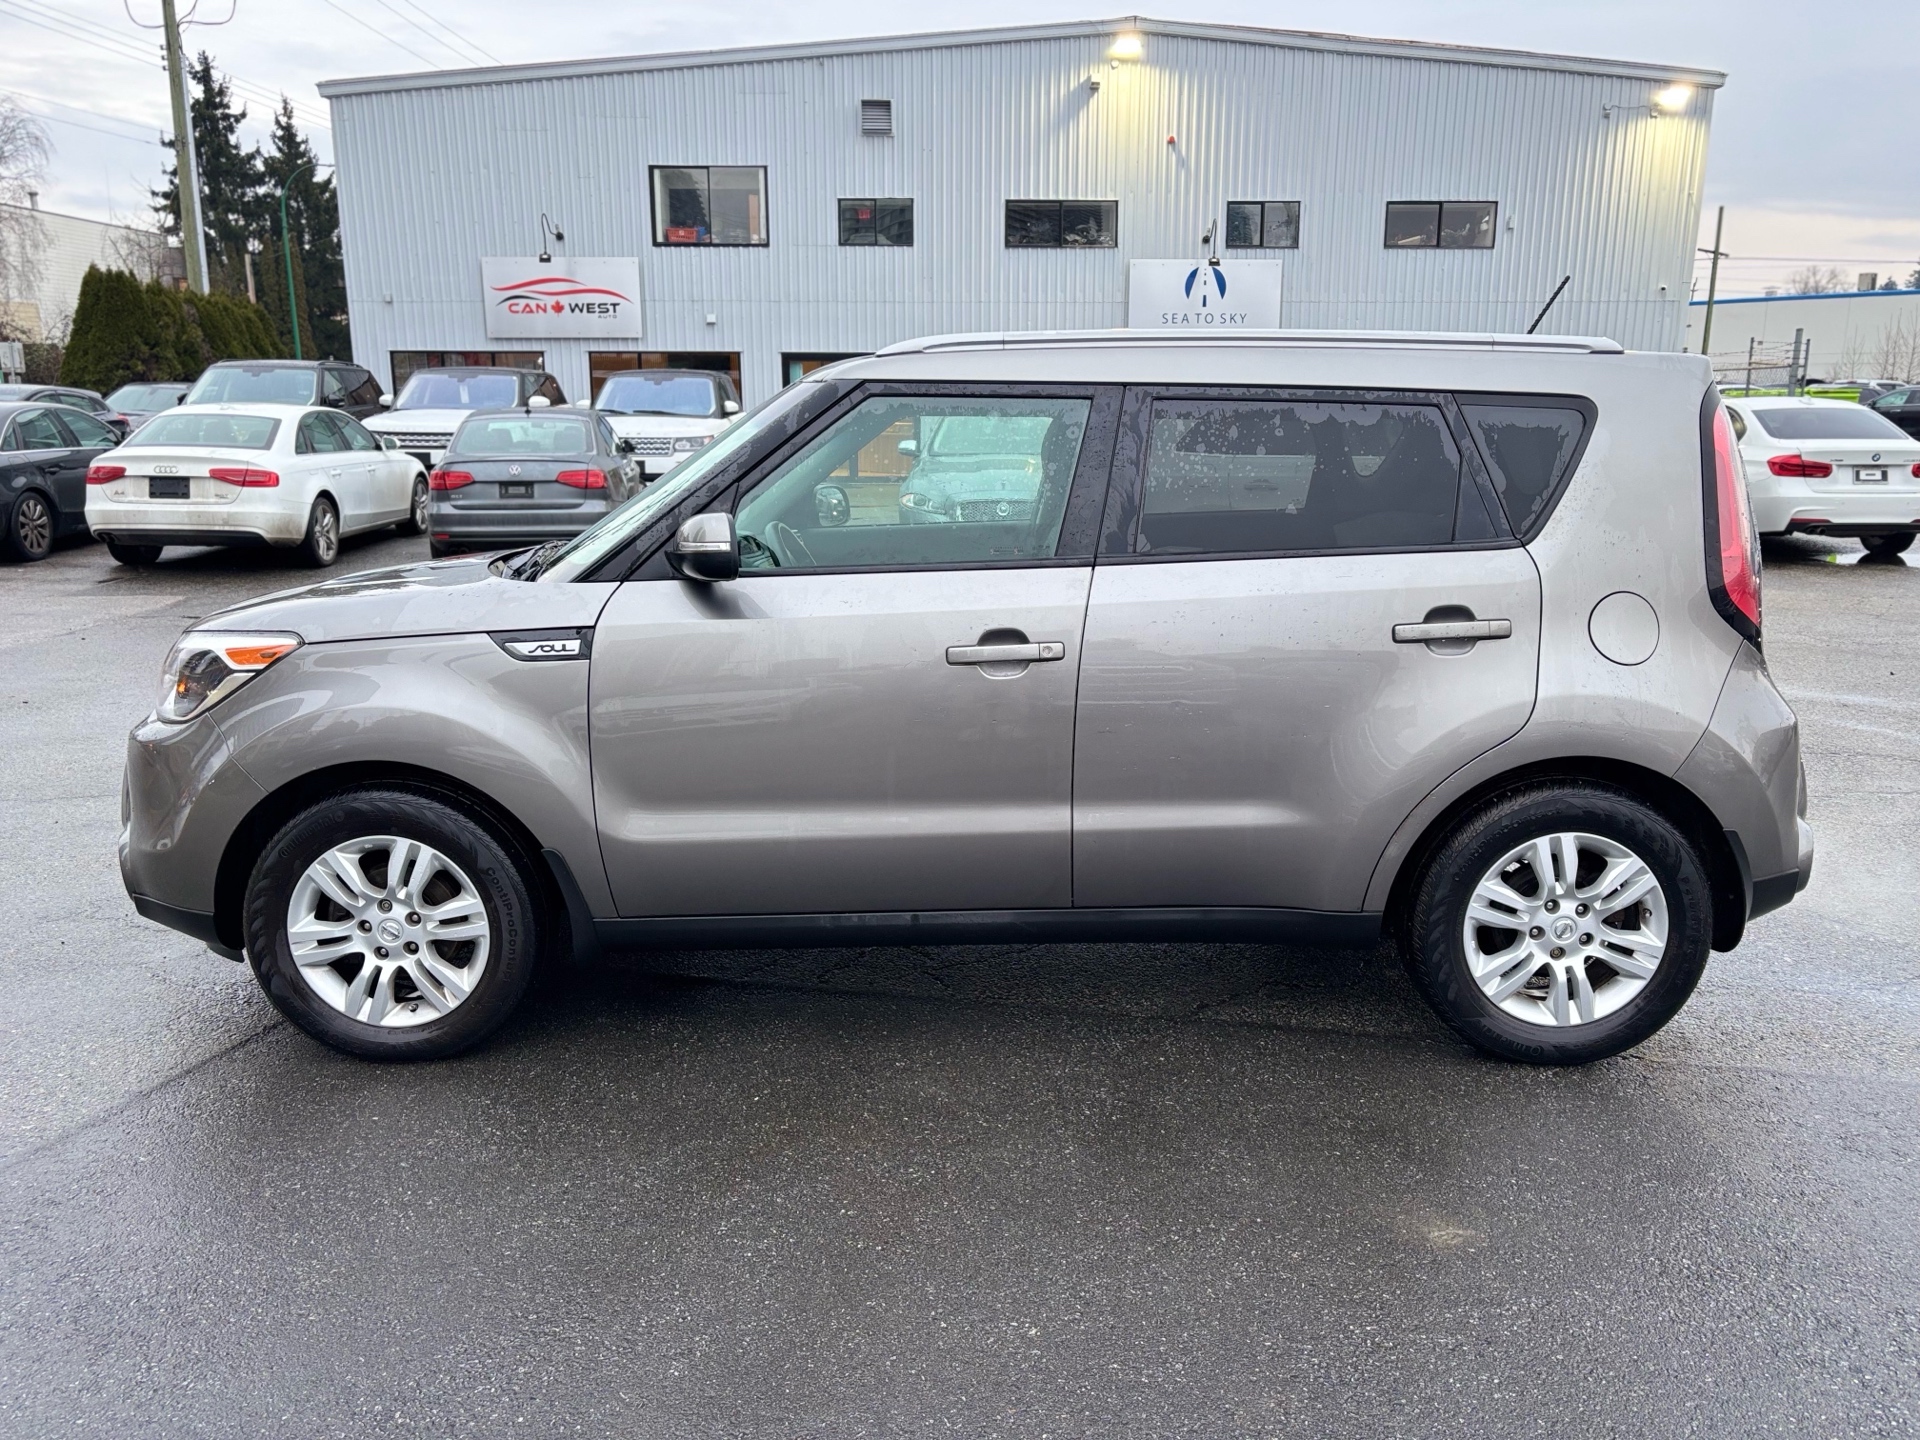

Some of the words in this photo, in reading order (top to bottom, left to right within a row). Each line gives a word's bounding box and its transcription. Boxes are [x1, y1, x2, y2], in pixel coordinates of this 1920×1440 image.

[507, 302, 547, 314] CAN
[568, 302, 621, 314] WEST
[1162, 313, 1190, 324] SEA
[1195, 313, 1214, 324] TO
[1219, 313, 1248, 324] SKY
[527, 643, 576, 653] SOUL
